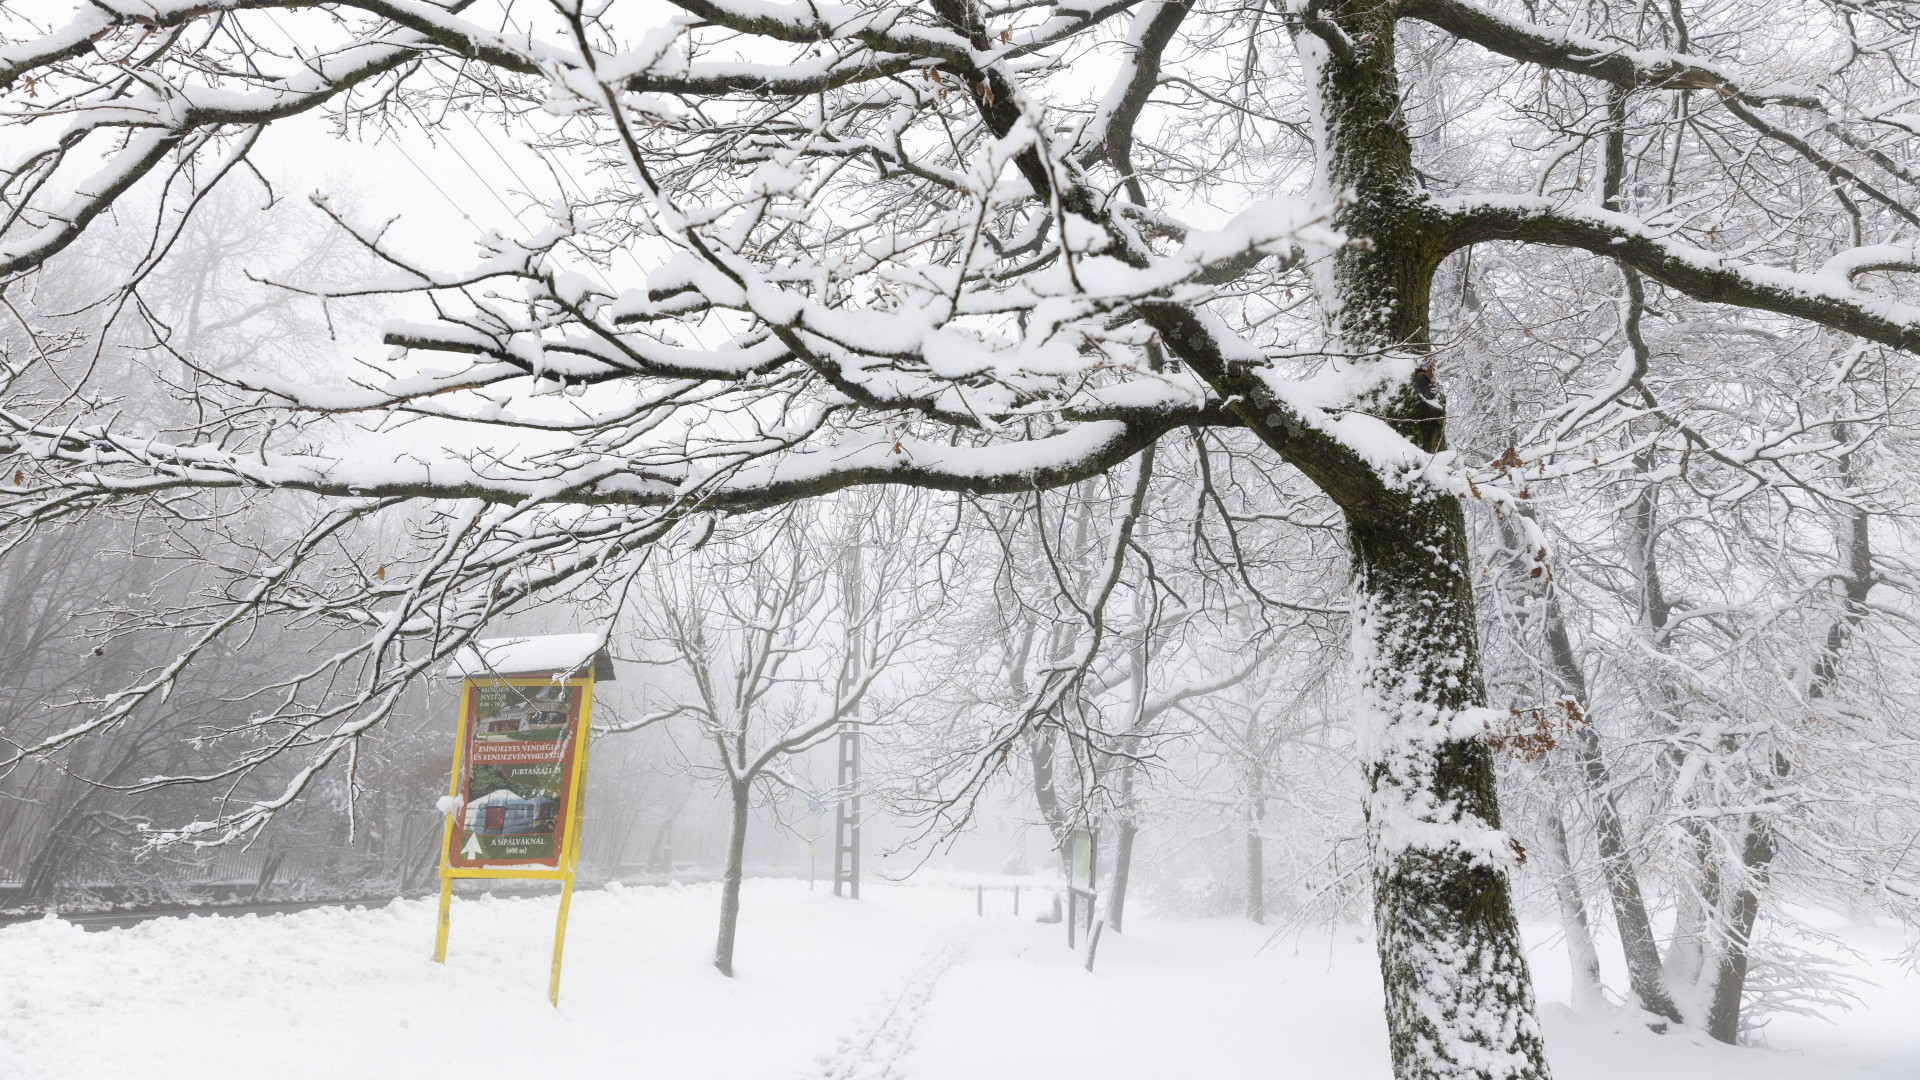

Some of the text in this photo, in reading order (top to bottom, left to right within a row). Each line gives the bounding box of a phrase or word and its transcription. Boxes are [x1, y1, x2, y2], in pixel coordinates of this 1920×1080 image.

[497, 836, 545, 846] SÍPÁLYÁKNÁL
[505, 846, 528, 855] (600 m)
